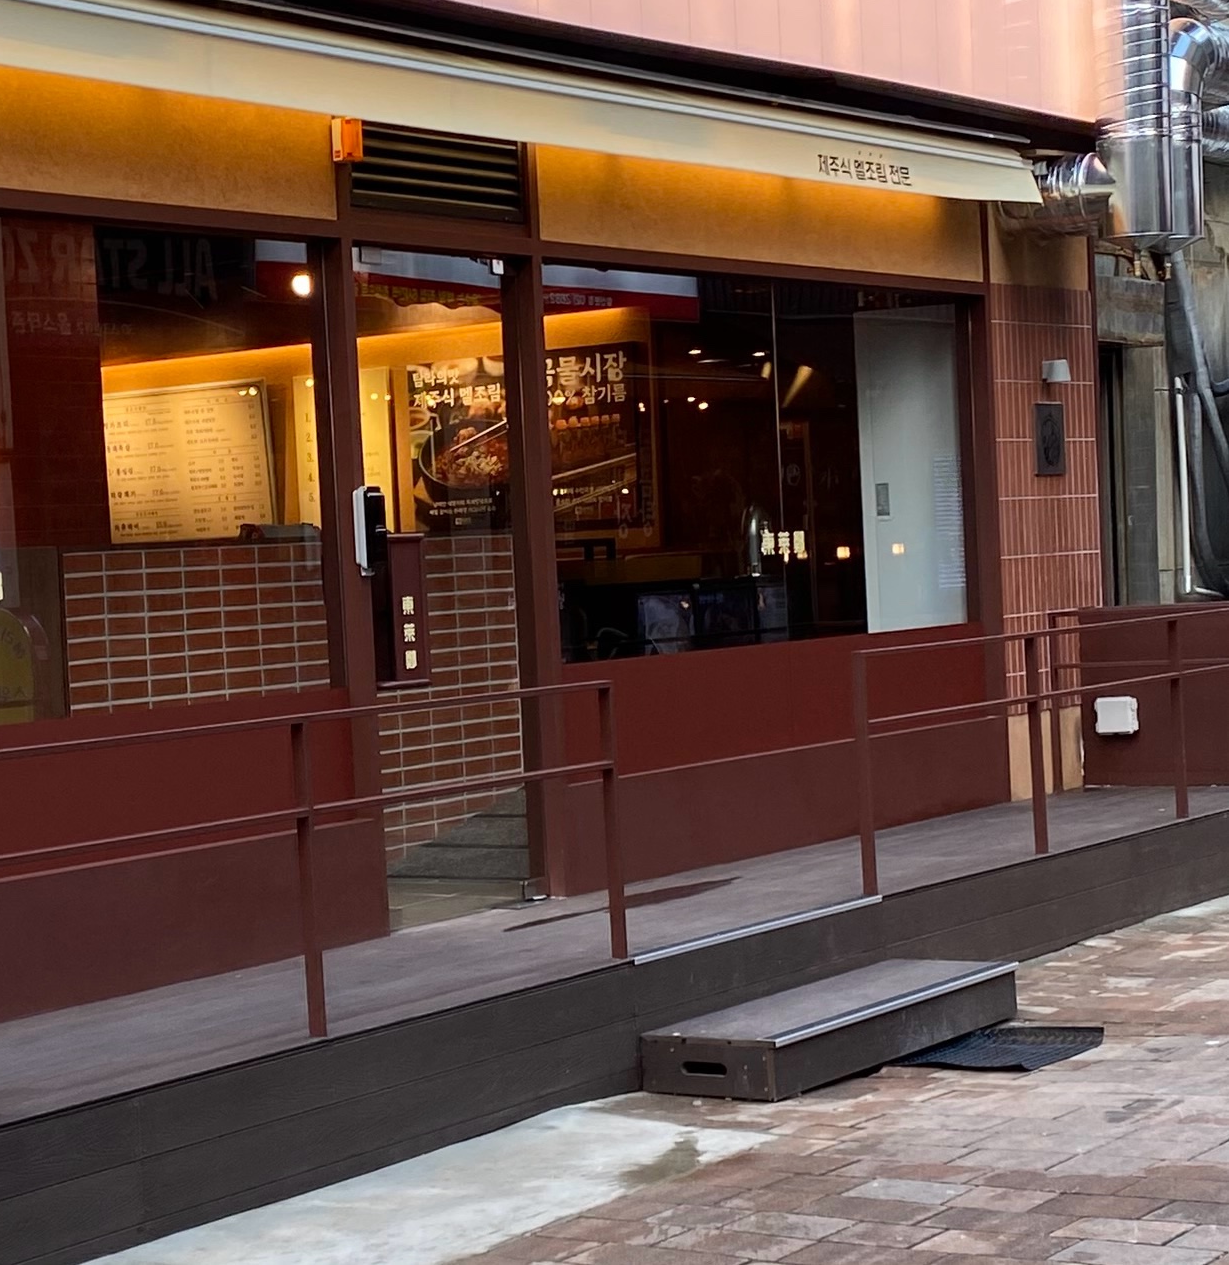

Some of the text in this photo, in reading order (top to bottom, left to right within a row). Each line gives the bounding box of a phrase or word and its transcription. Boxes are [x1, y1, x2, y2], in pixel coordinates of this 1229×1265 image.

[818, 154, 852, 179] 제주식
[889, 165, 912, 186] 전문
[582, 384, 627, 405] 참기름
